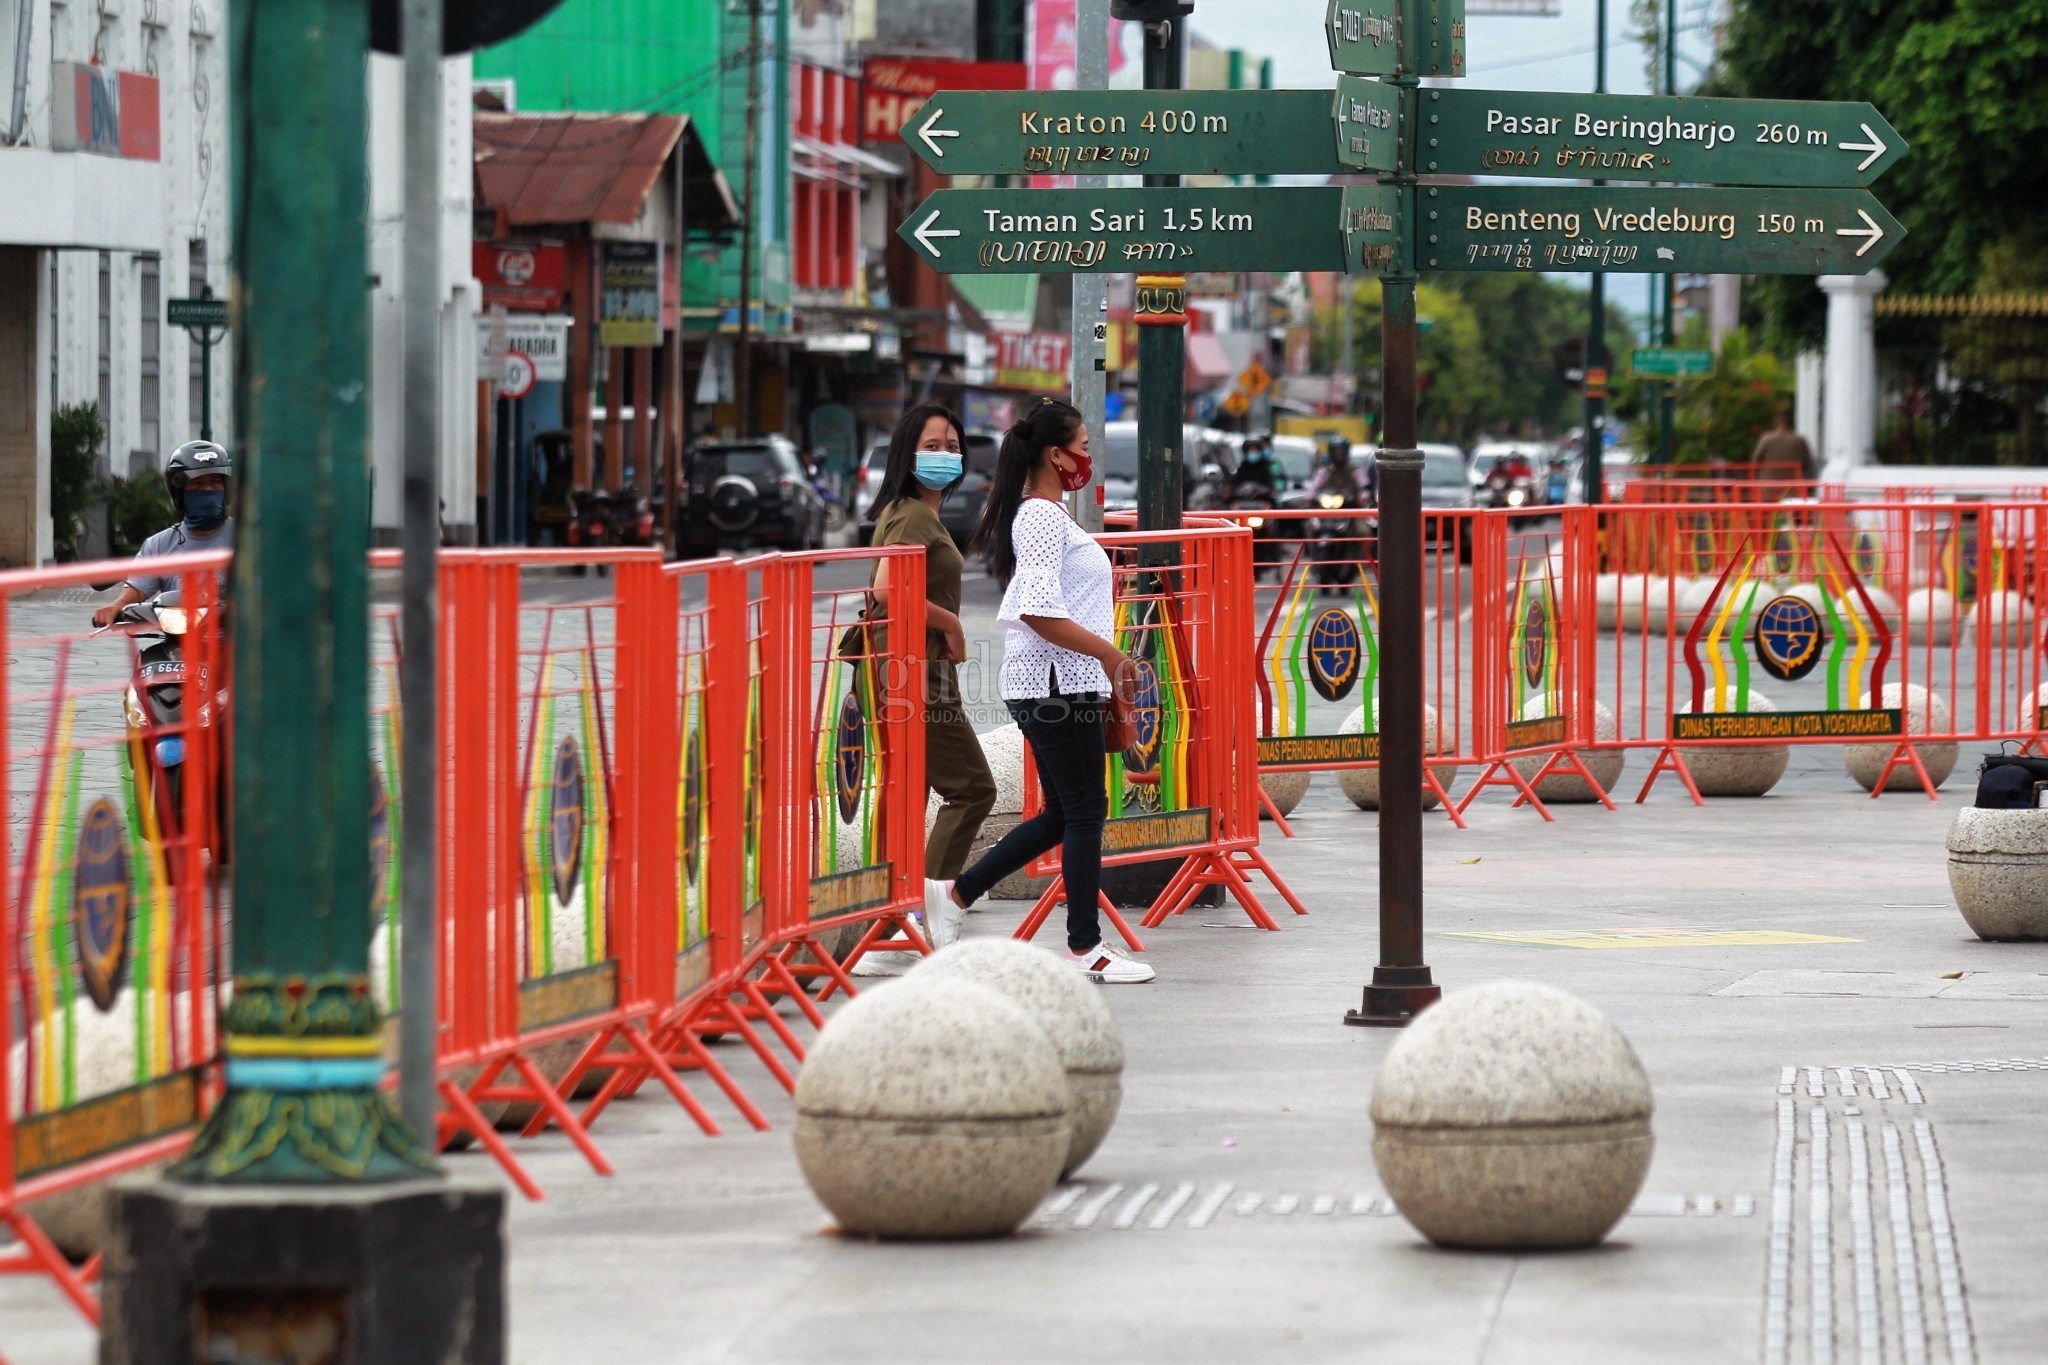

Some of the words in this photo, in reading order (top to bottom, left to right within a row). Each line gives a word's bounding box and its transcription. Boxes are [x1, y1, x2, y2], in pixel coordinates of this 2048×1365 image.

[1341, 9, 1361, 42] TOILET
[1021, 111, 1126, 134] Kraton
[1486, 109, 1562, 135] Pasar
[1574, 113, 1736, 150] Beringharjo
[1756, 123, 1800, 144] 260
[1806, 129, 1828, 145] m
[983, 209, 1077, 232] Taman
[1090, 208, 1145, 232] Sari
[1466, 206, 1580, 238] Benteng
[1593, 206, 1736, 240] Vredeburg
[1757, 214, 1796, 234] 150
[1804, 218, 1824, 233] m
[1003, 333, 1067, 373] TIKET
[1680, 717, 1711, 738] DINAS
[1713, 716, 1792, 737] PERHUBUNGAN
[1794, 715, 1823, 736] KOTA
[1823, 713, 1892, 734] YOGYAKARTA
[1257, 741, 1280, 762] DINAS
[1281, 739, 1341, 761] PERHUBUNGAN
[1342, 738, 1362, 758] KOTA
